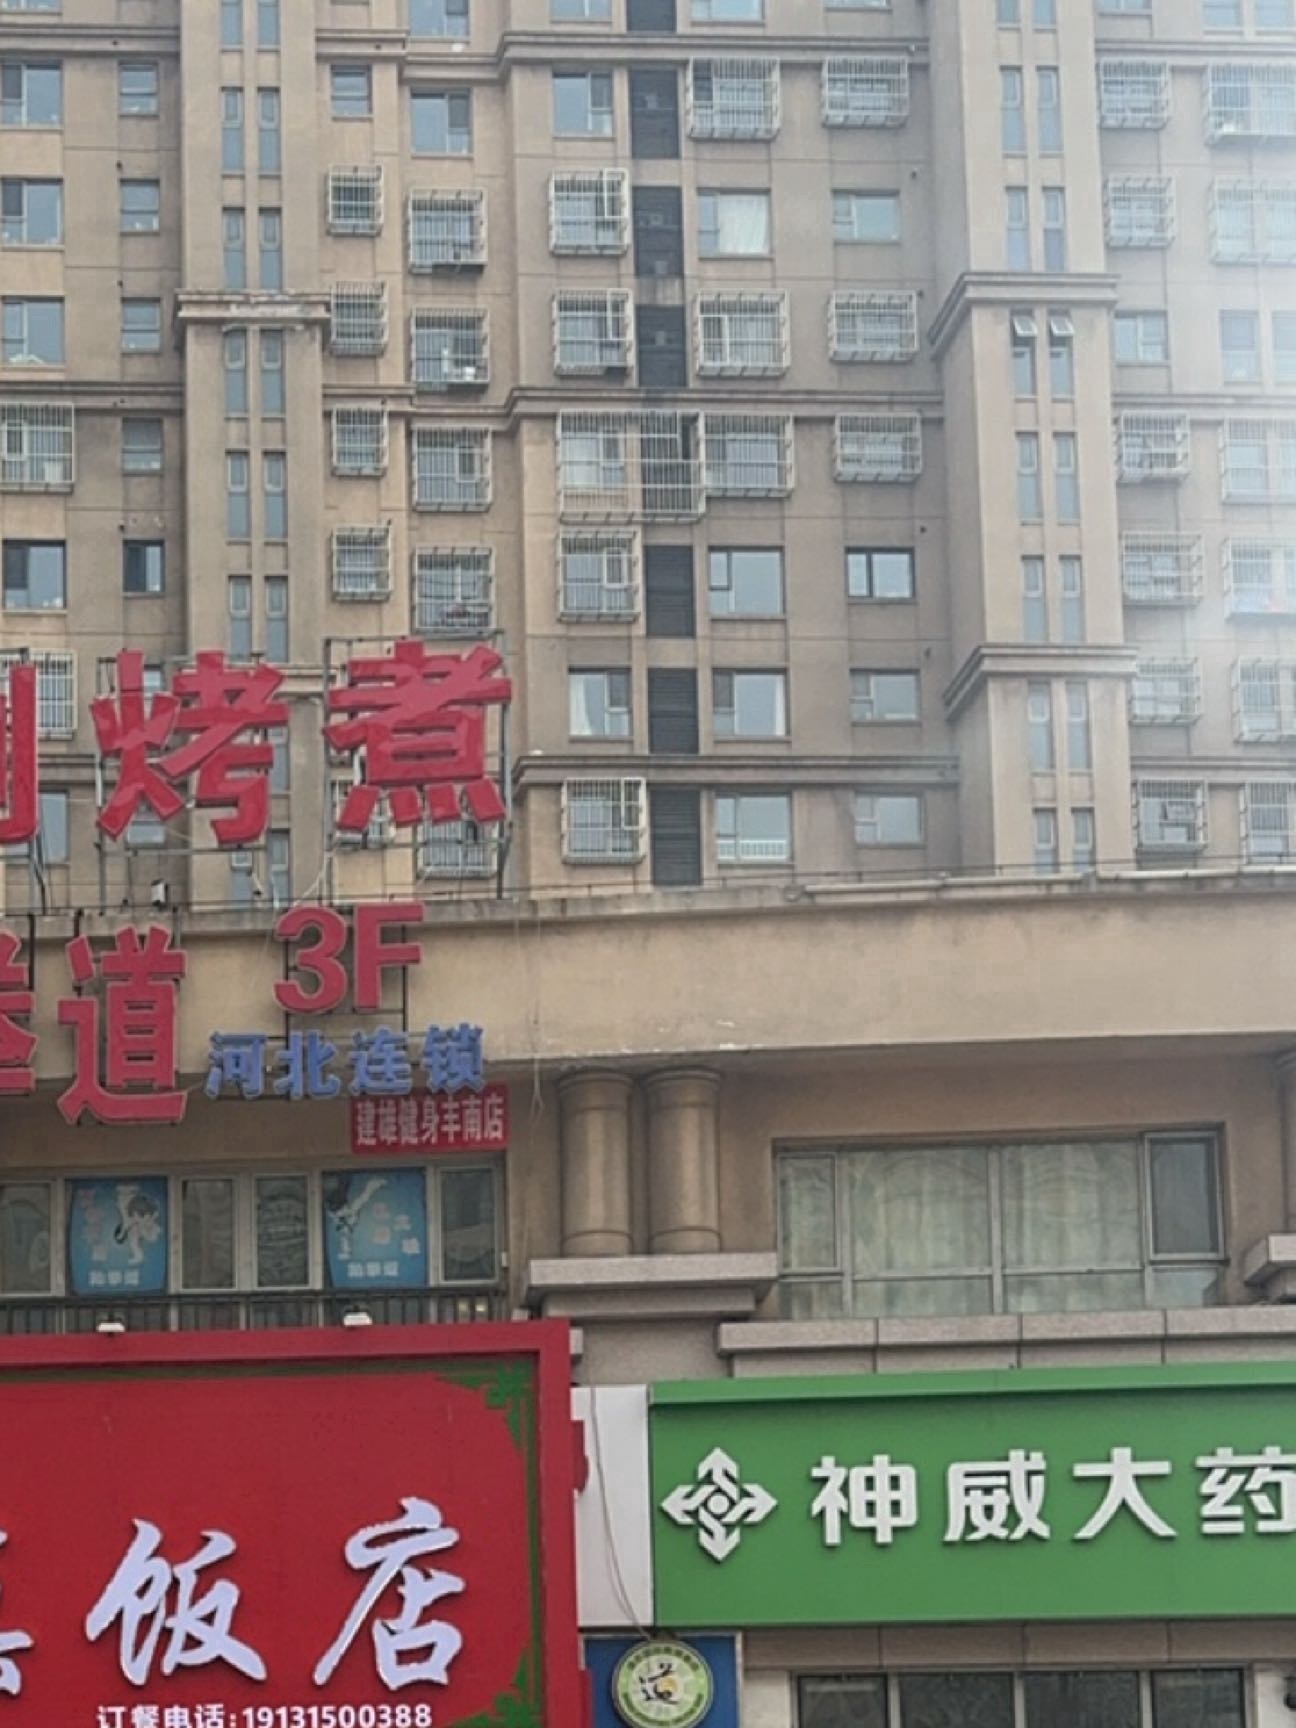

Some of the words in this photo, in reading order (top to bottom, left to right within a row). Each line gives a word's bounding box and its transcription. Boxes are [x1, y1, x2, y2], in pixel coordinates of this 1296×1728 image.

[273, 901, 426, 1014] 3F
[206, 1022, 486, 1099] 河北连锁
[811, 1445, 1296, 1548] 神威大药
